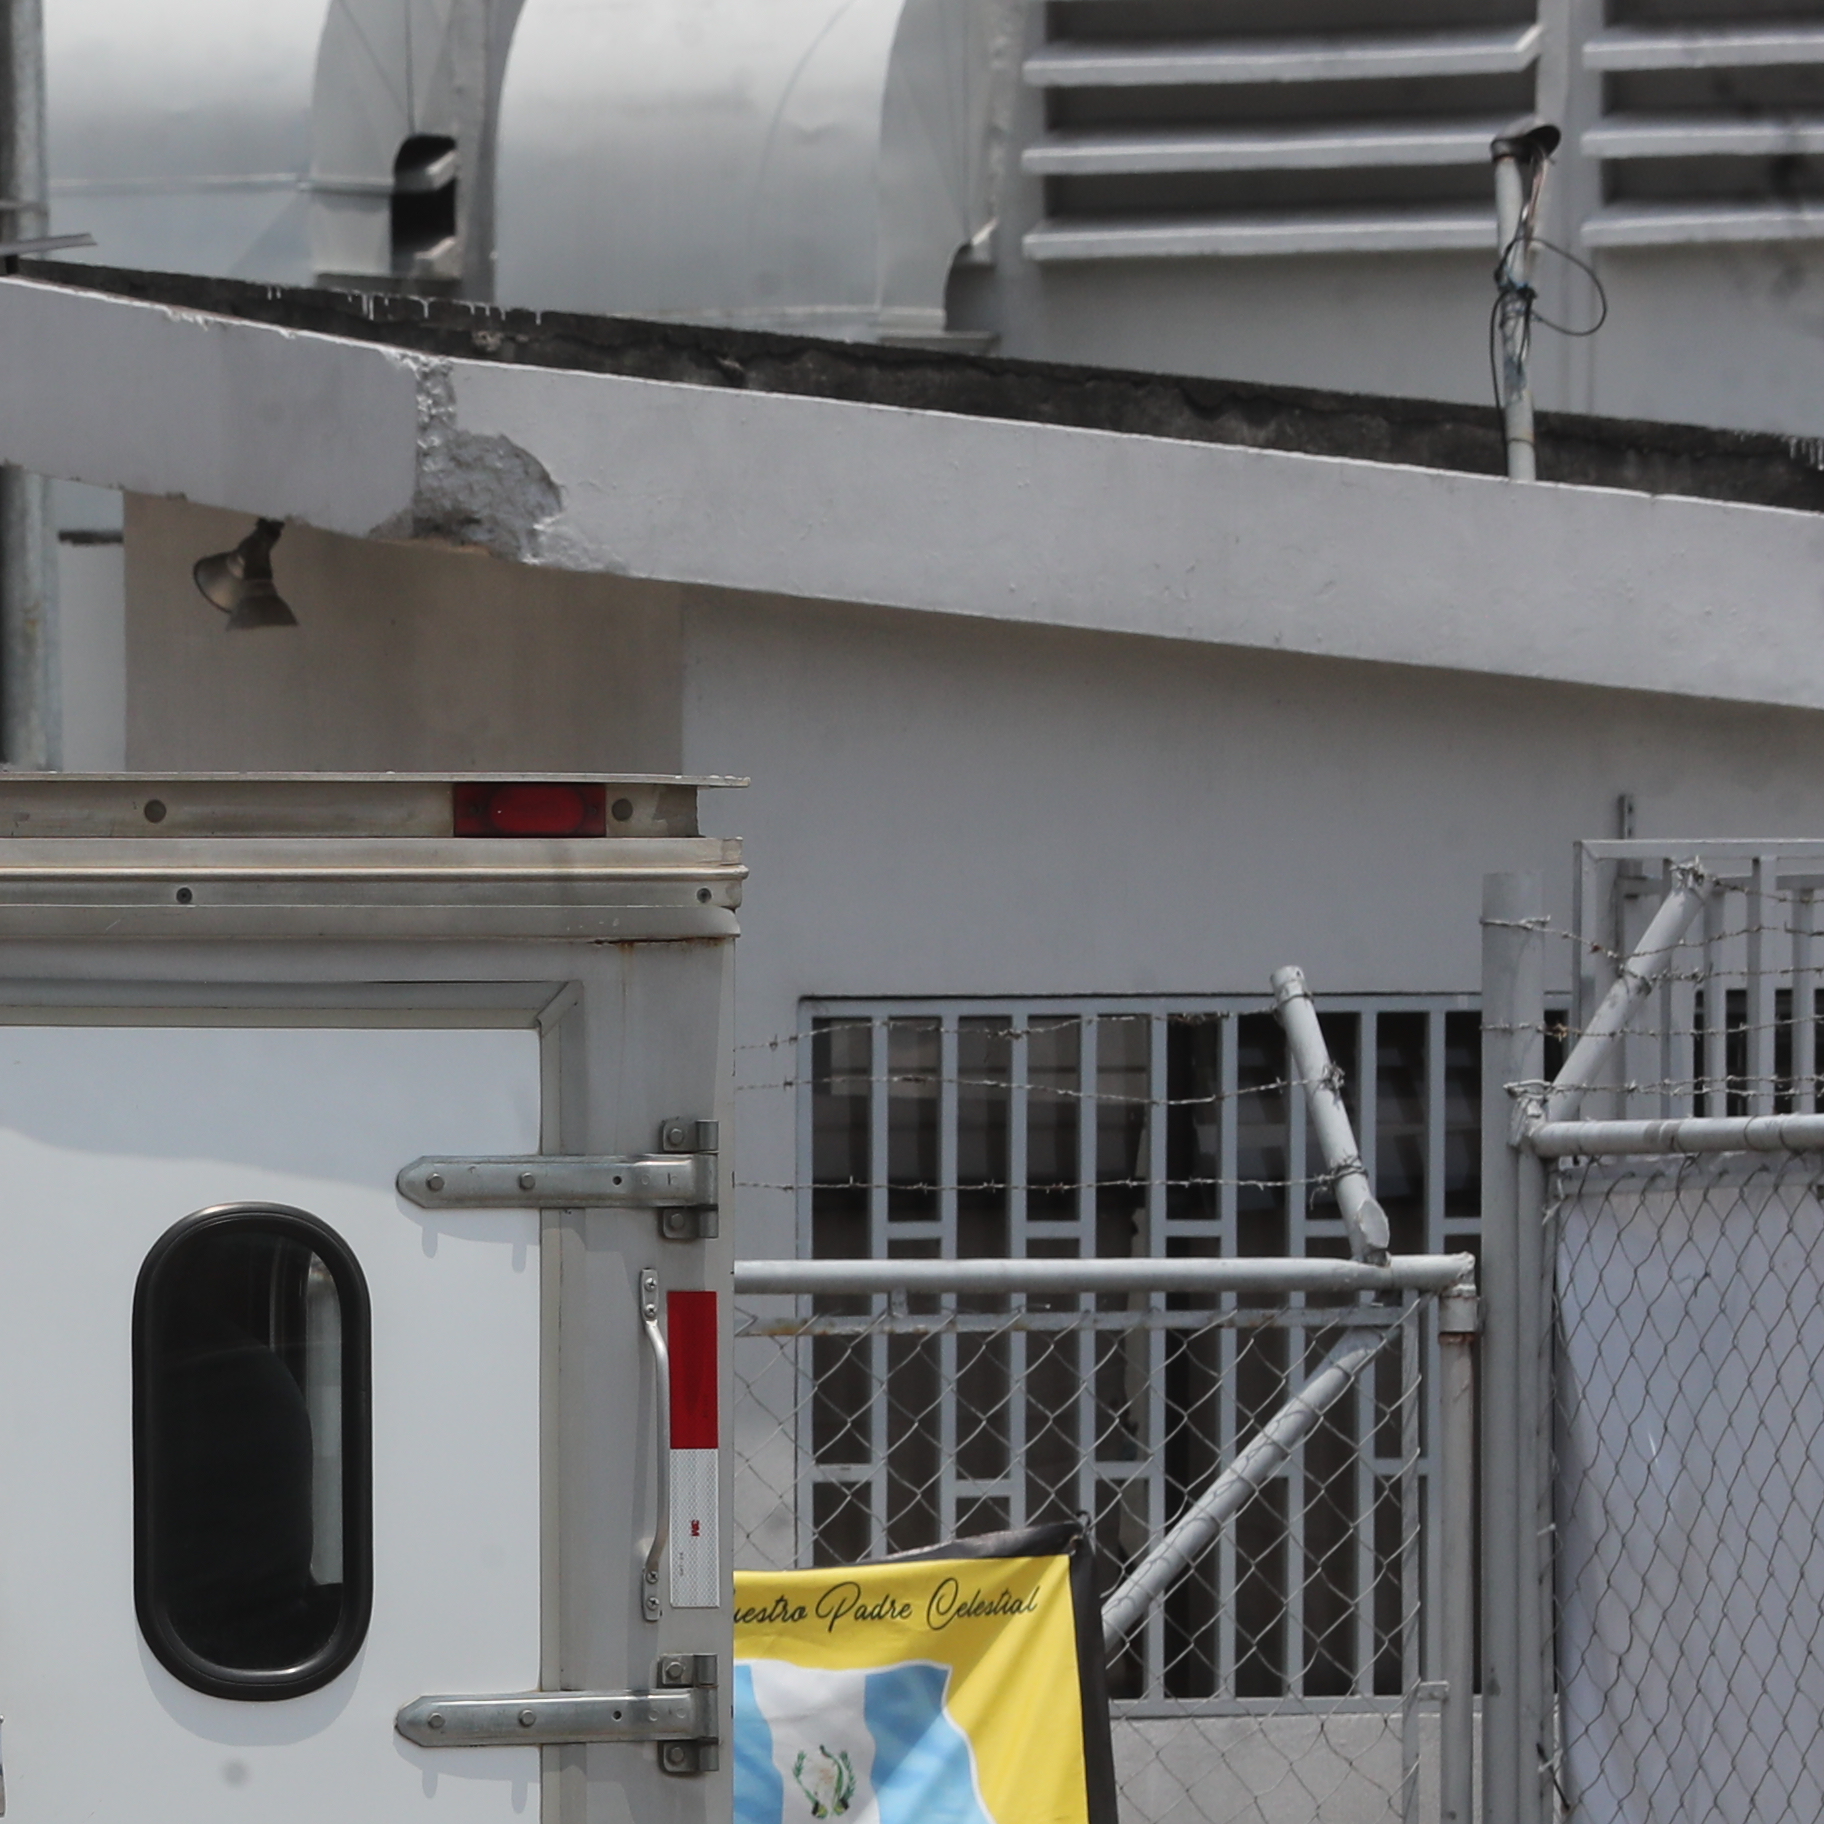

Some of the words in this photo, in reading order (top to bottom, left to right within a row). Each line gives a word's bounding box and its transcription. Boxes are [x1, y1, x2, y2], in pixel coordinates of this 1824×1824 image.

[691, 1519, 700, 1537] 3M
[815, 1581, 913, 1633] Padre
[926, 1576, 1041, 1631] Celestial
